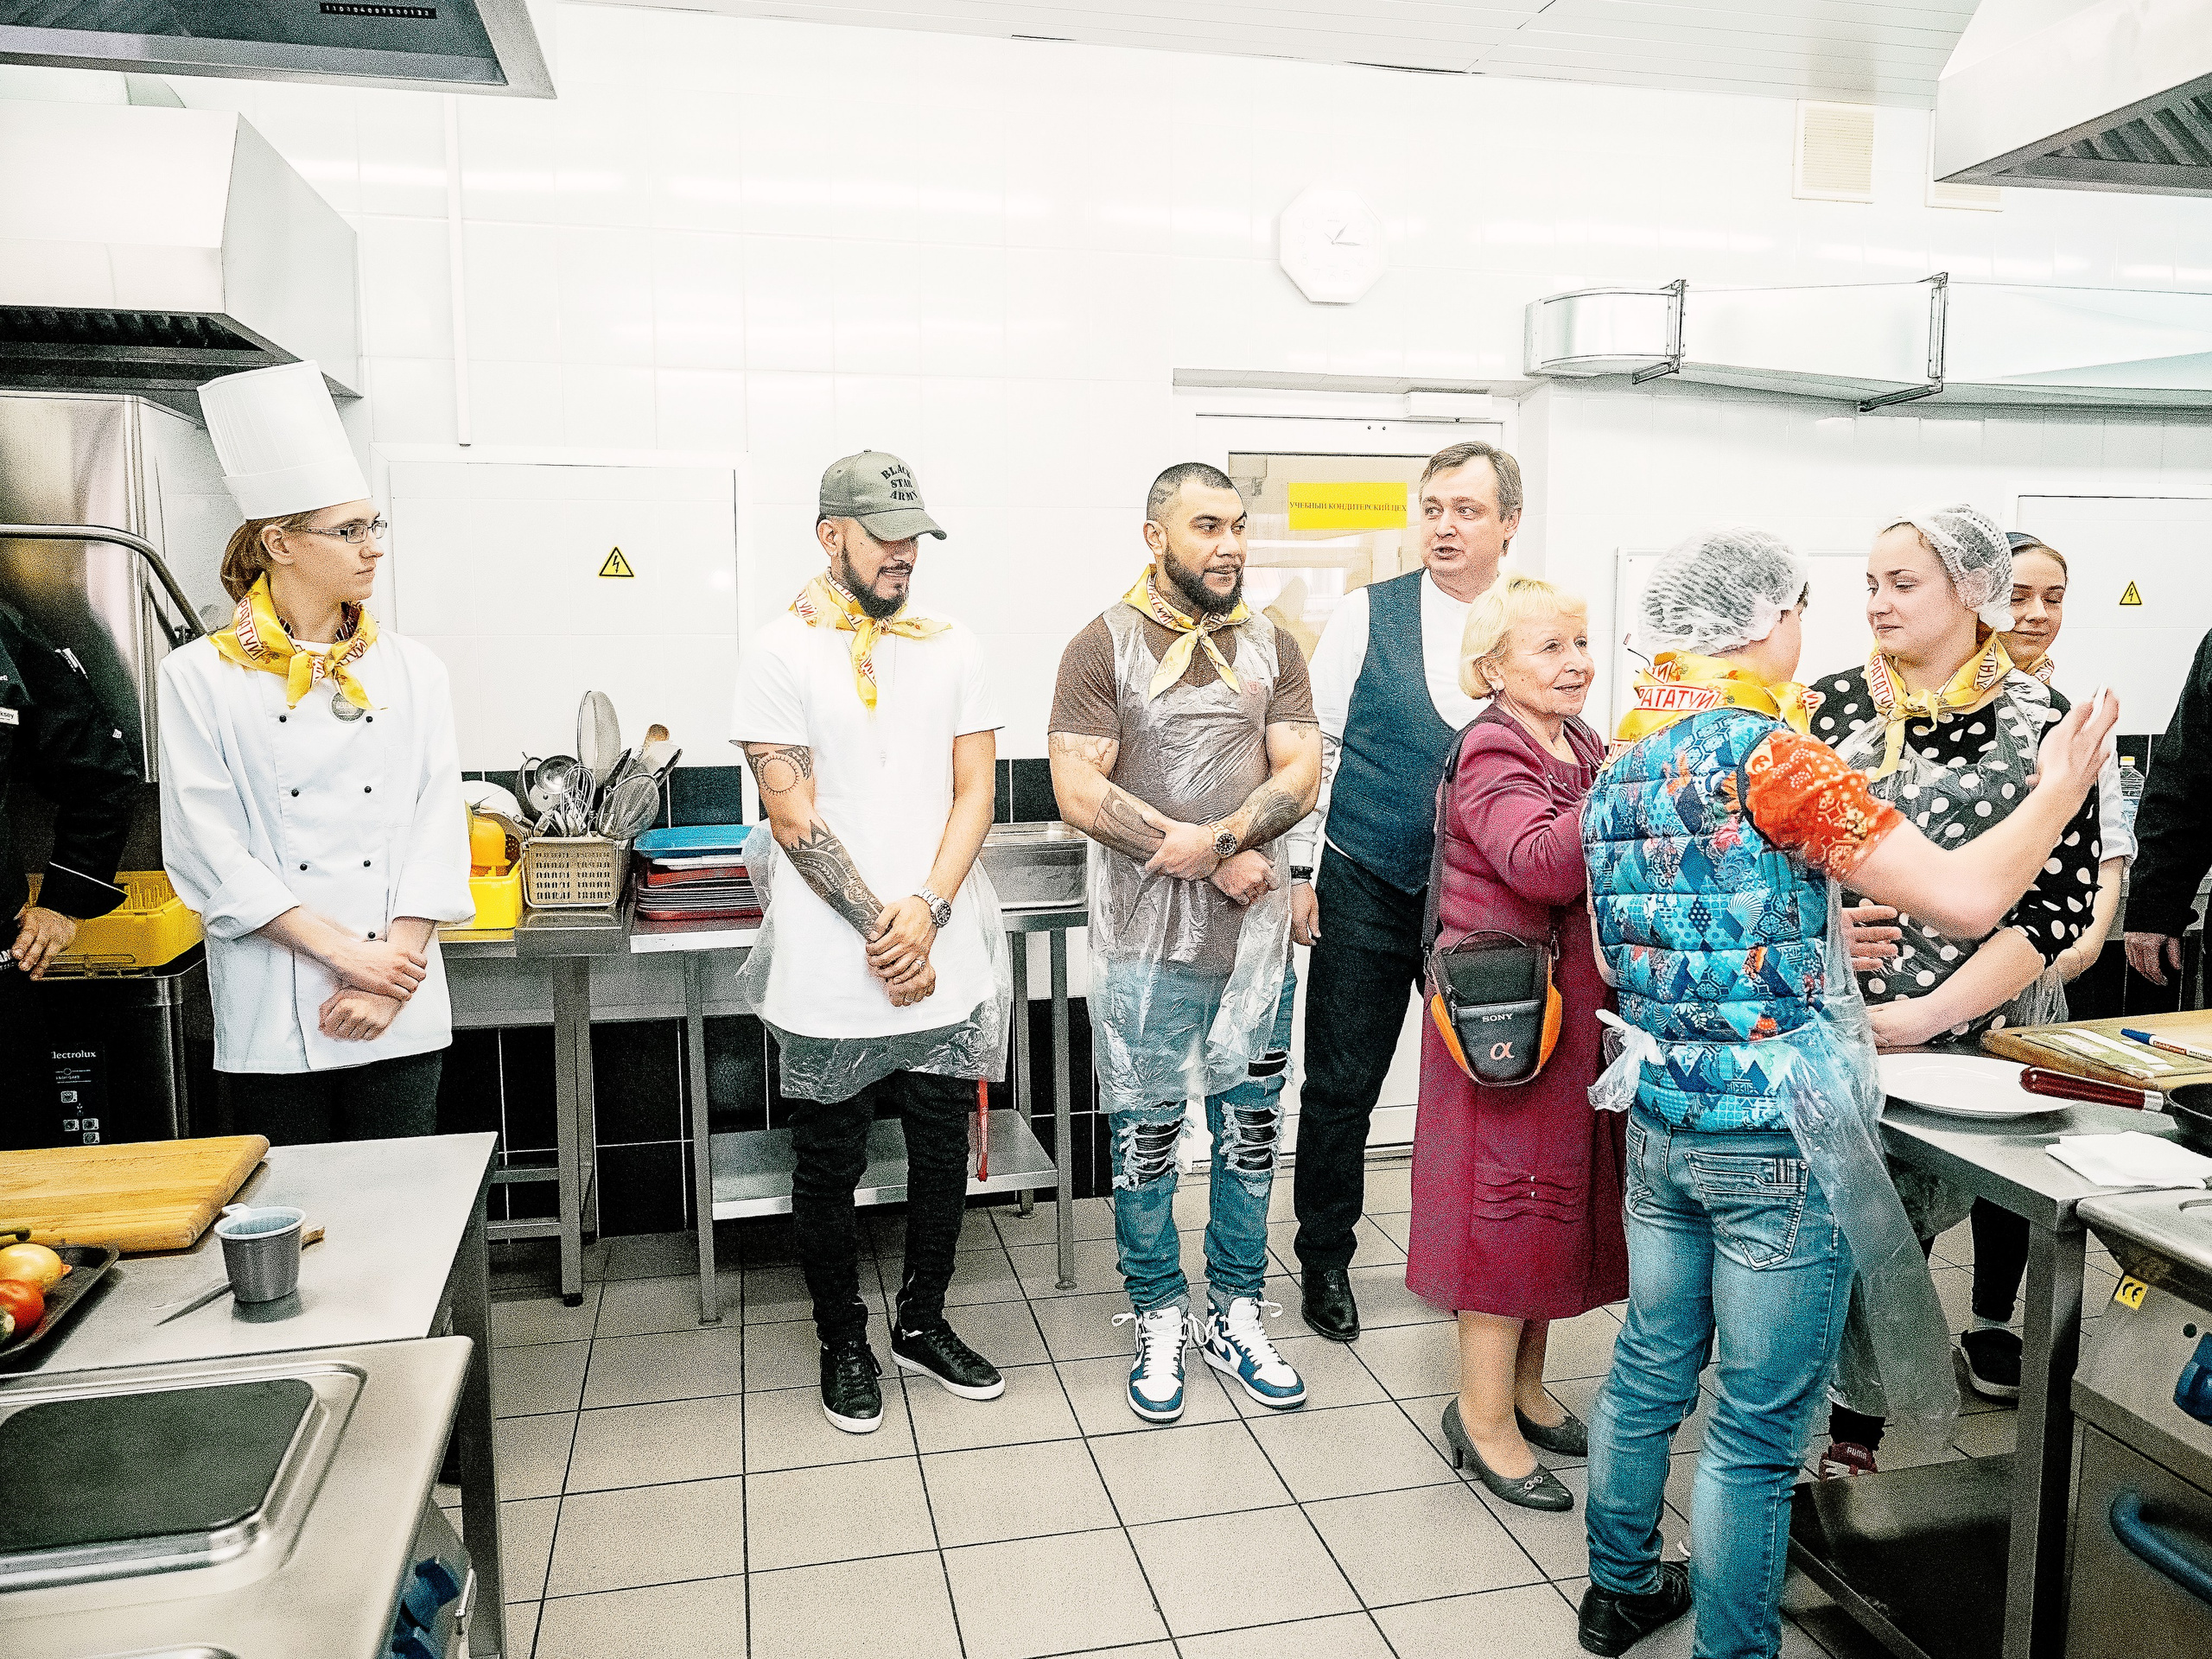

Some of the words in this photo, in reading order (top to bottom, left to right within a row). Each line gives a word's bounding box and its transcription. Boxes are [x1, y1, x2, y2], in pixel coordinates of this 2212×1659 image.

[880, 464, 912, 480] BLACK
[891, 479, 913, 488] STAR
[890, 490, 918, 501] ARMY
[1482, 1013, 1514, 1023] SONY
[50, 1050, 97, 1059] lectrolux
